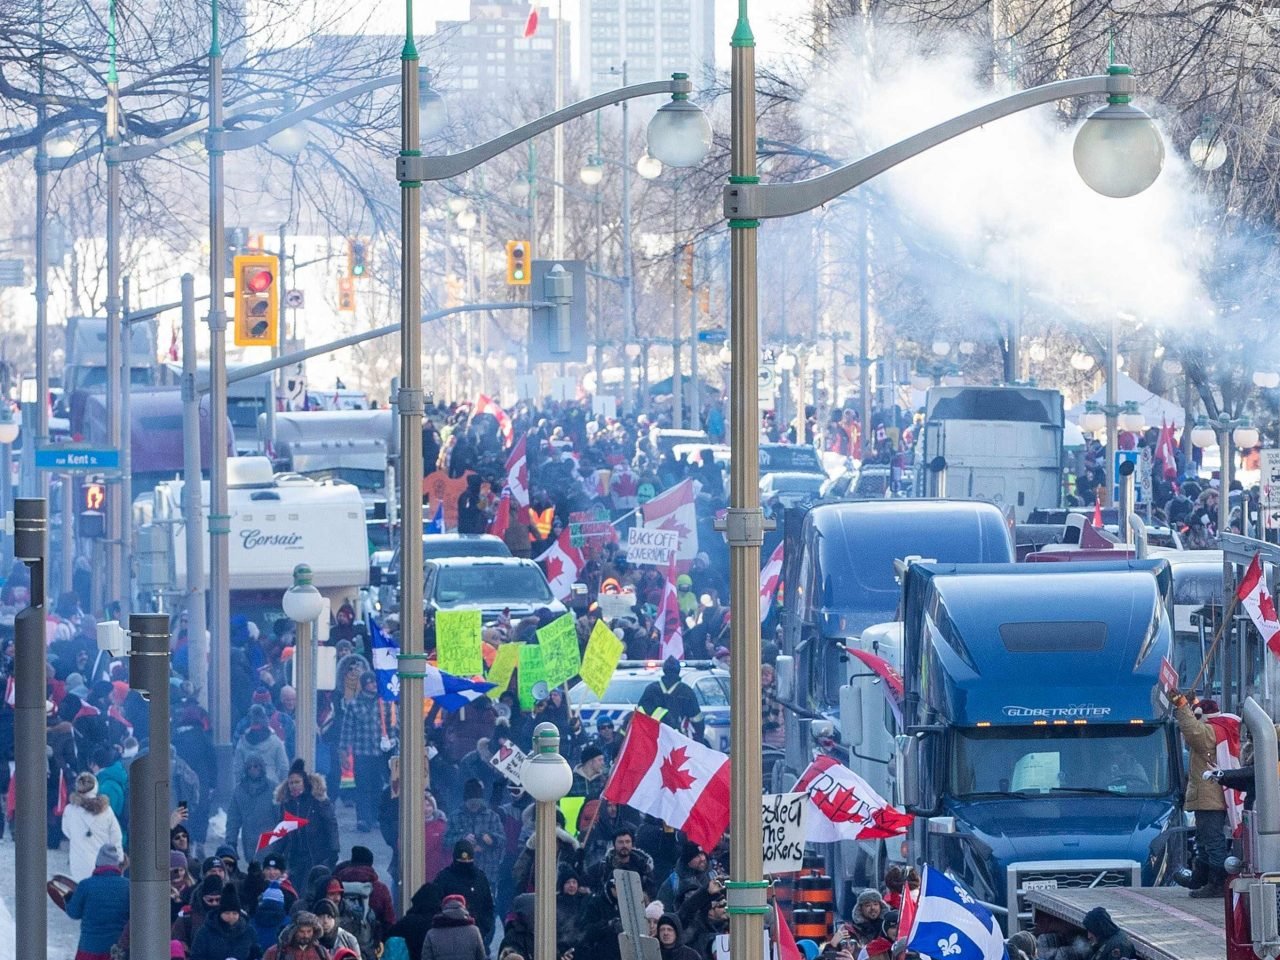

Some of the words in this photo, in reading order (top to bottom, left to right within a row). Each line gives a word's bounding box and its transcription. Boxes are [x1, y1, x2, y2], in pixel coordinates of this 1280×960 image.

[68, 454, 88, 465] Kent
[240, 529, 302, 549] Corsair
[630, 529, 655, 546] BACK
[656, 531, 677, 548] OFF
[1007, 707, 1111, 717] GLOBETROTTER
